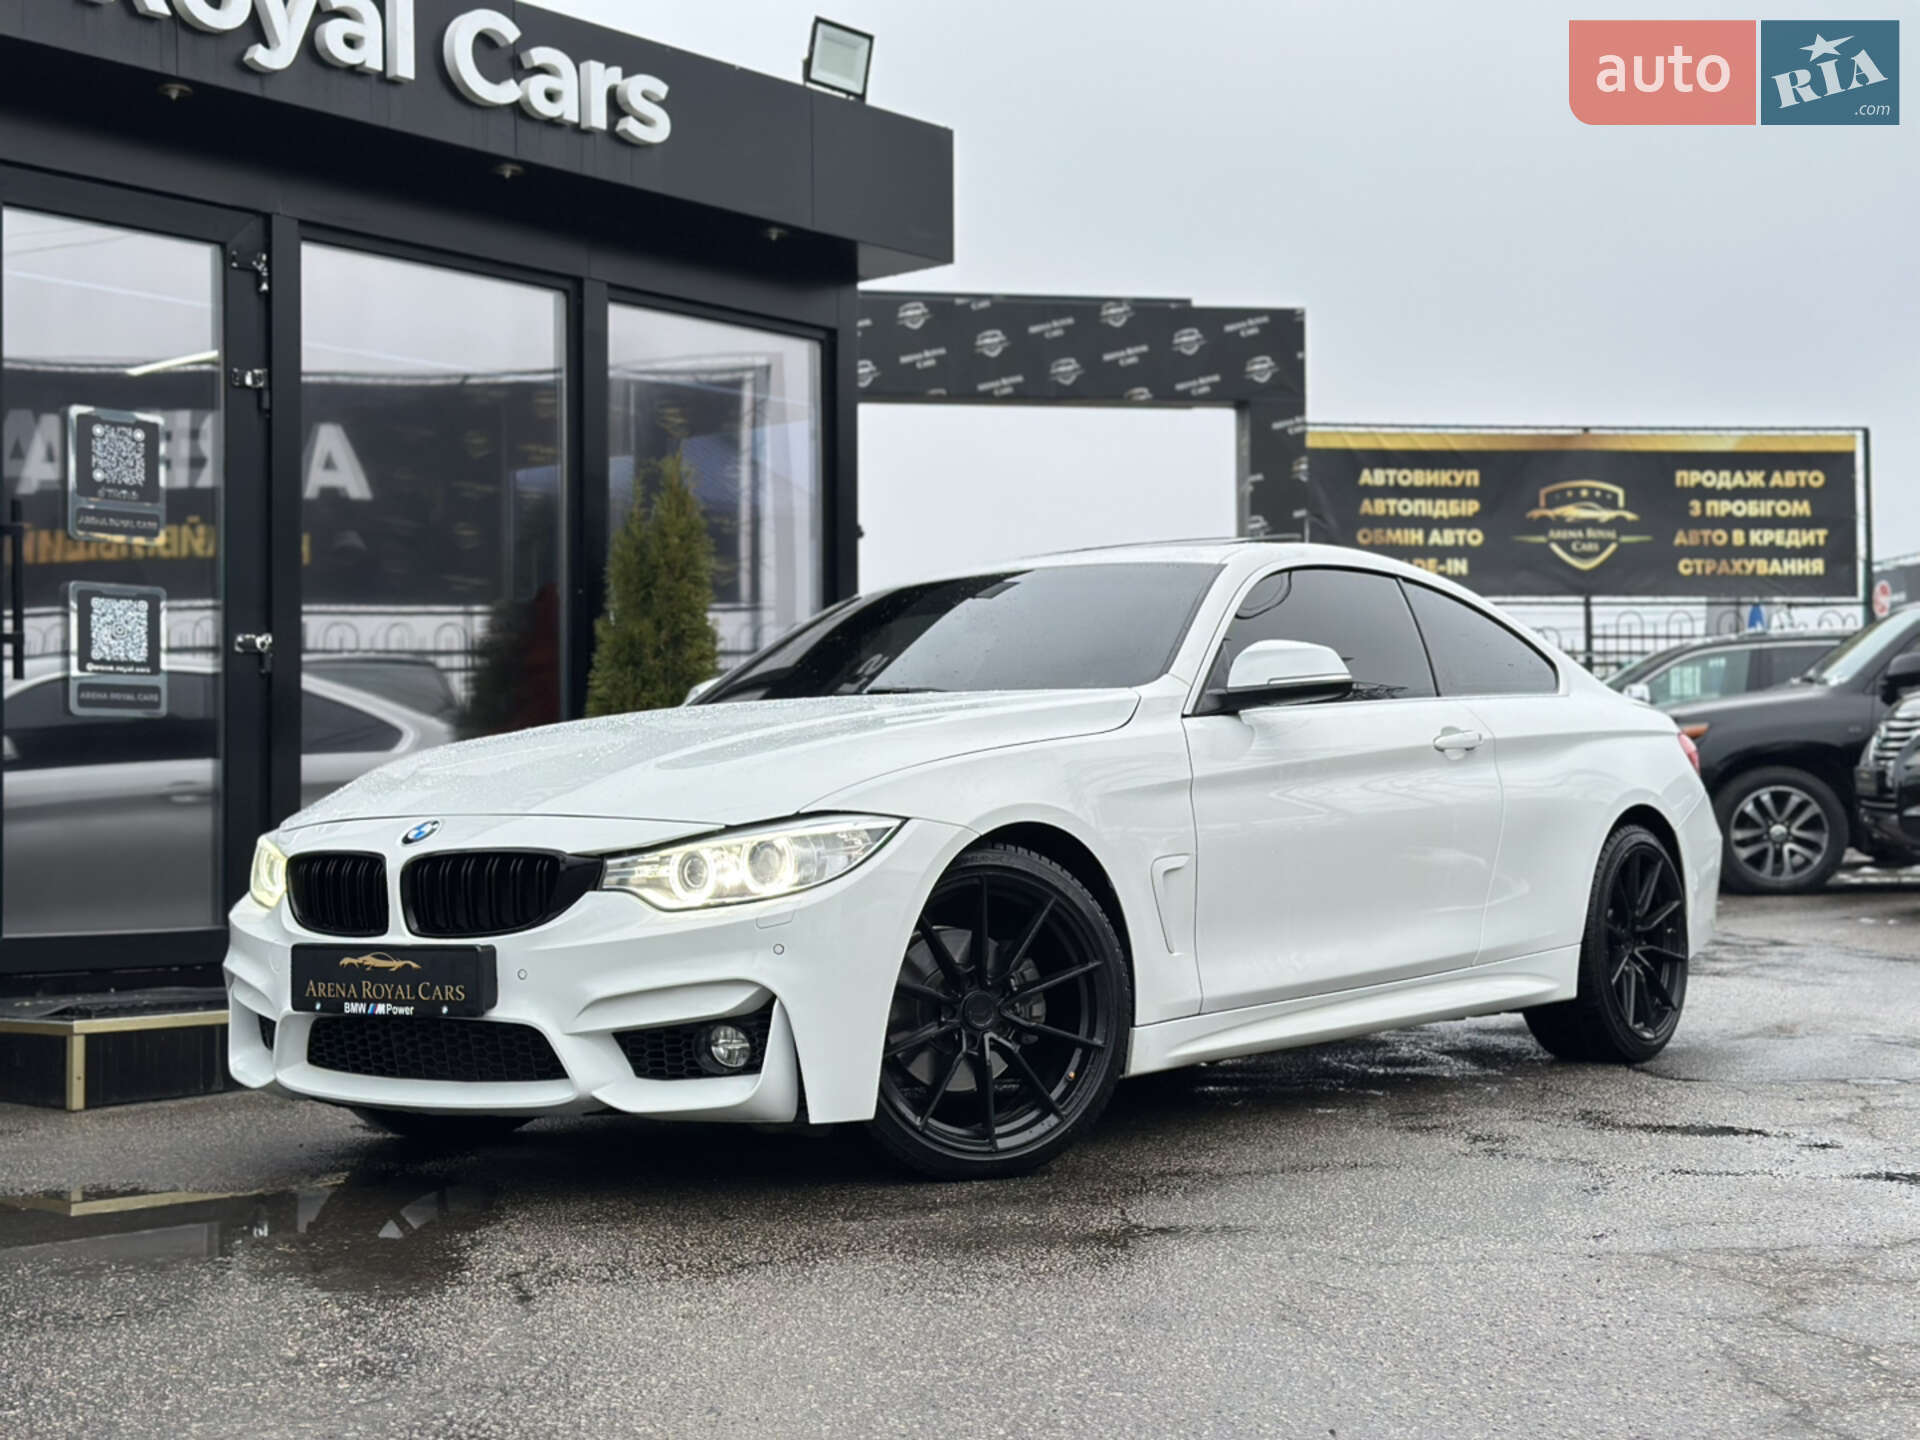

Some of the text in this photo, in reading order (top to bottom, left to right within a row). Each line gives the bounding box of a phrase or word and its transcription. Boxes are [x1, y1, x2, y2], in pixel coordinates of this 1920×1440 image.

[443, 8, 671, 145] Cars
[1358, 468, 1480, 487] АВТОВИКУП
[1674, 470, 1826, 490] ПРОДАЖ АВТО
[1360, 498, 1481, 519] АВТОПІДБІР
[1705, 499, 1812, 517] ПРОБІГОМ
[1356, 528, 1485, 546] ОБМІН АВТО
[1673, 528, 1829, 549] АВТО В КРЕДИТ
[1677, 557, 1826, 576] СТРАХУВАННЯ
[305, 978, 466, 1002] ARENA ROYAL CARS
[343, 1002, 367, 1014] BMW
